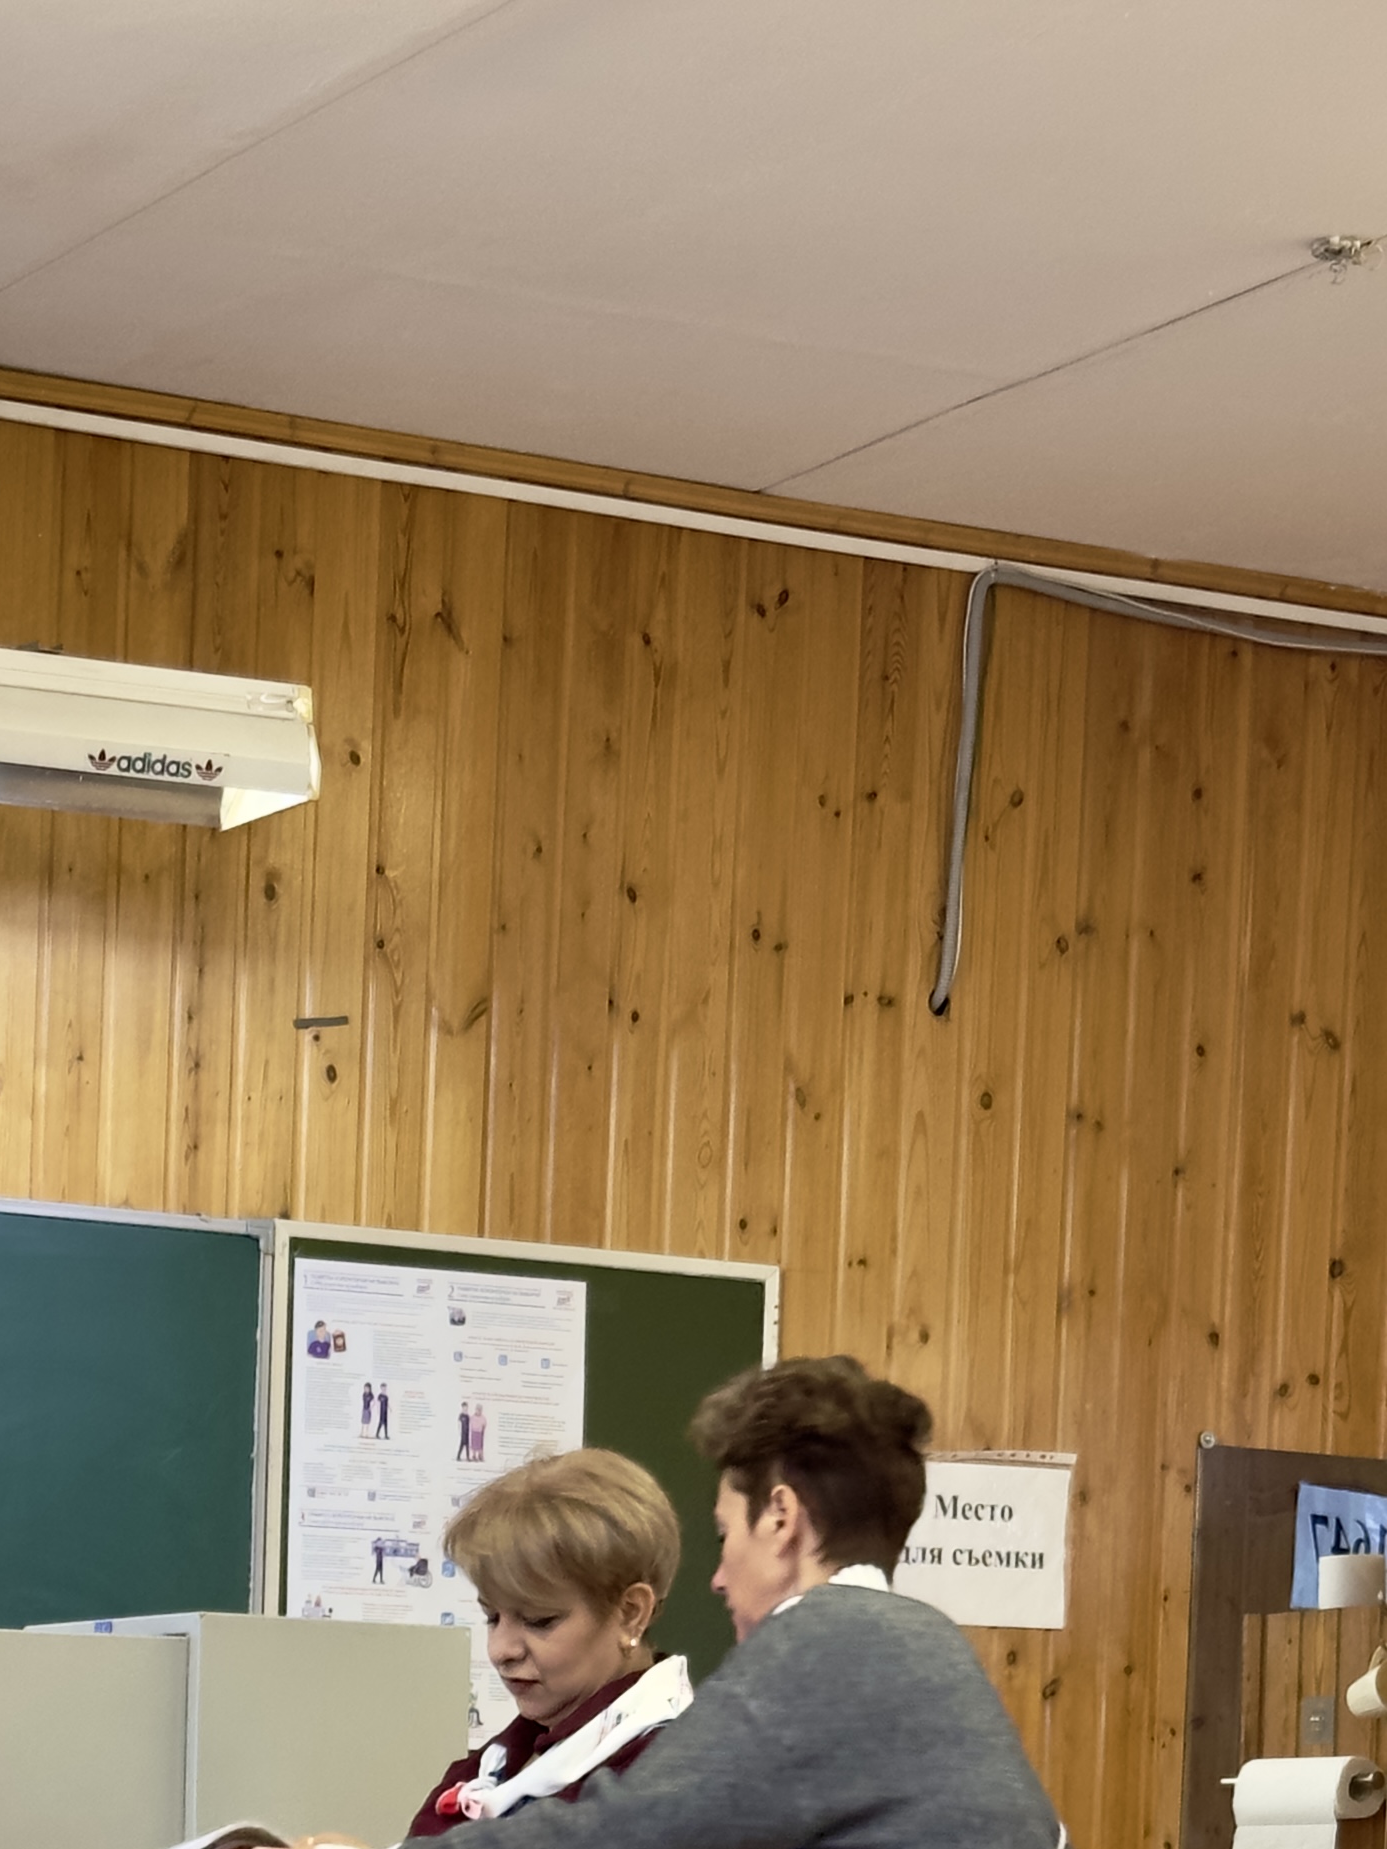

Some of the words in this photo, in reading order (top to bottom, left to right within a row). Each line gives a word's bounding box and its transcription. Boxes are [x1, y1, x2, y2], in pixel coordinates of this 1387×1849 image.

[116, 752, 192, 779] adidas
[934, 1494, 1014, 1522] Место
[952, 1547, 1045, 1570] съемки
